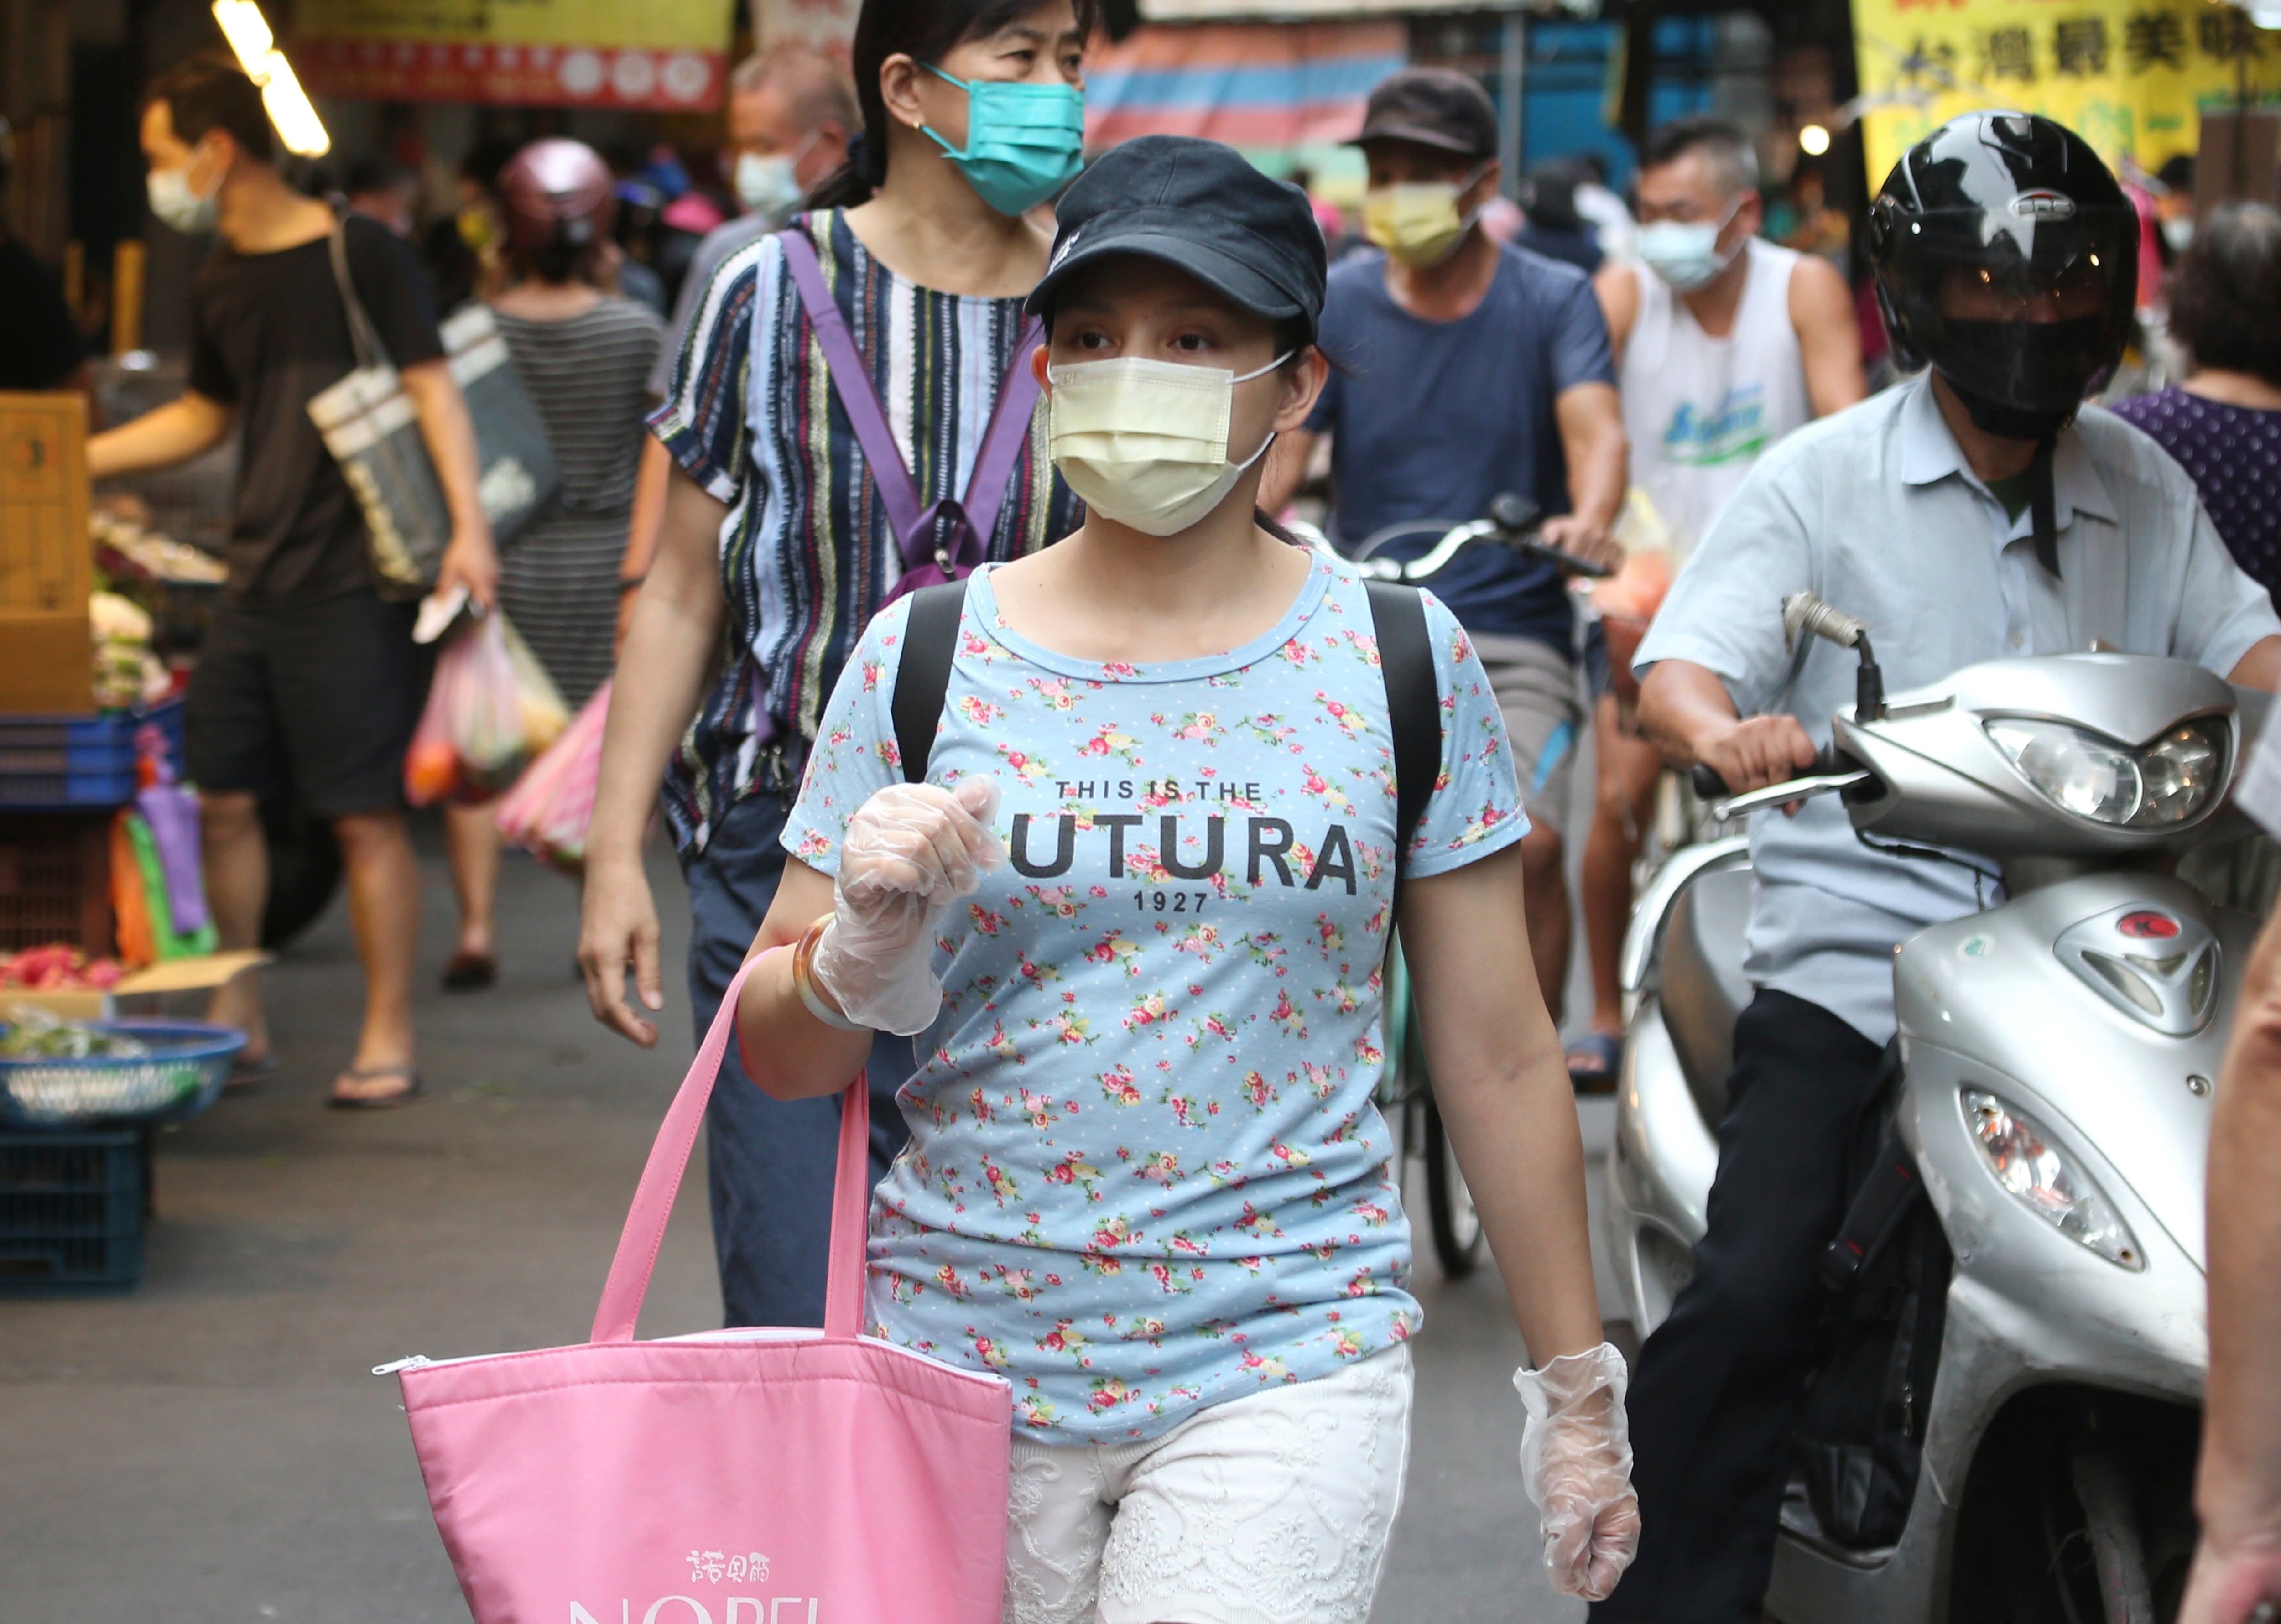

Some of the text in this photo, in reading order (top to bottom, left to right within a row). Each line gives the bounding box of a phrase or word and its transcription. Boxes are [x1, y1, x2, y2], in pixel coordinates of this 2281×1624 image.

[1056, 780, 1261, 801] THIS IS THE
[994, 814, 1357, 896] UTURA
[1134, 890, 1208, 913] 1927
[685, 1549, 770, 1585] 諾貝爾
